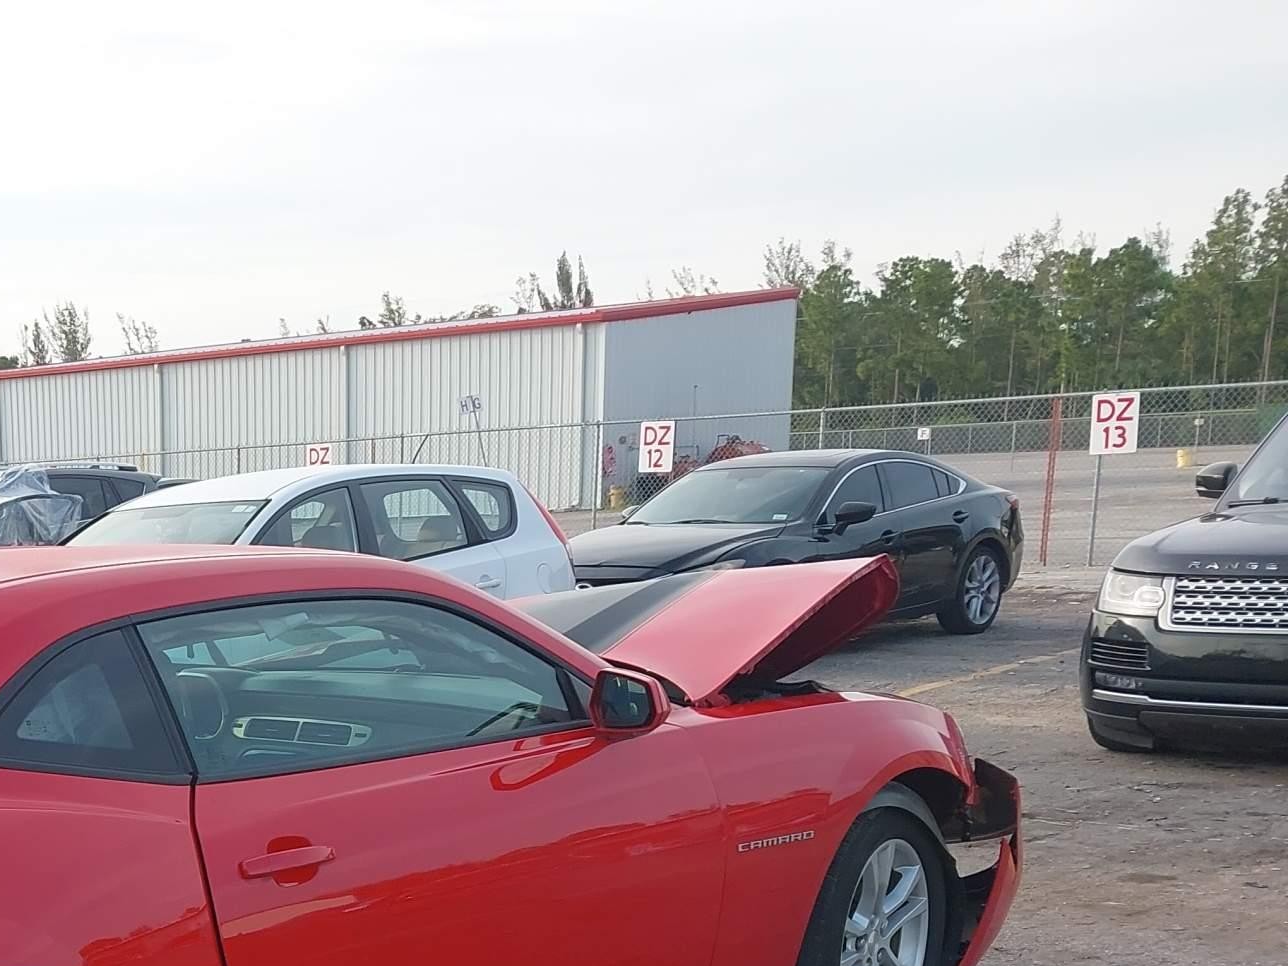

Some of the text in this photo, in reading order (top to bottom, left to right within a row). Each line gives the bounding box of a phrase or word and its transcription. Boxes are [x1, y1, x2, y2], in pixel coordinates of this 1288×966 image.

[1096, 398, 1135, 423] DZ
[644, 426, 671, 445] DZ
[1102, 425, 1127, 449] 13
[308, 447, 330, 465] DZ
[648, 449, 663, 468] 12
[1188, 561, 1279, 570] RANGE
[737, 830, 815, 852] CAMARO
